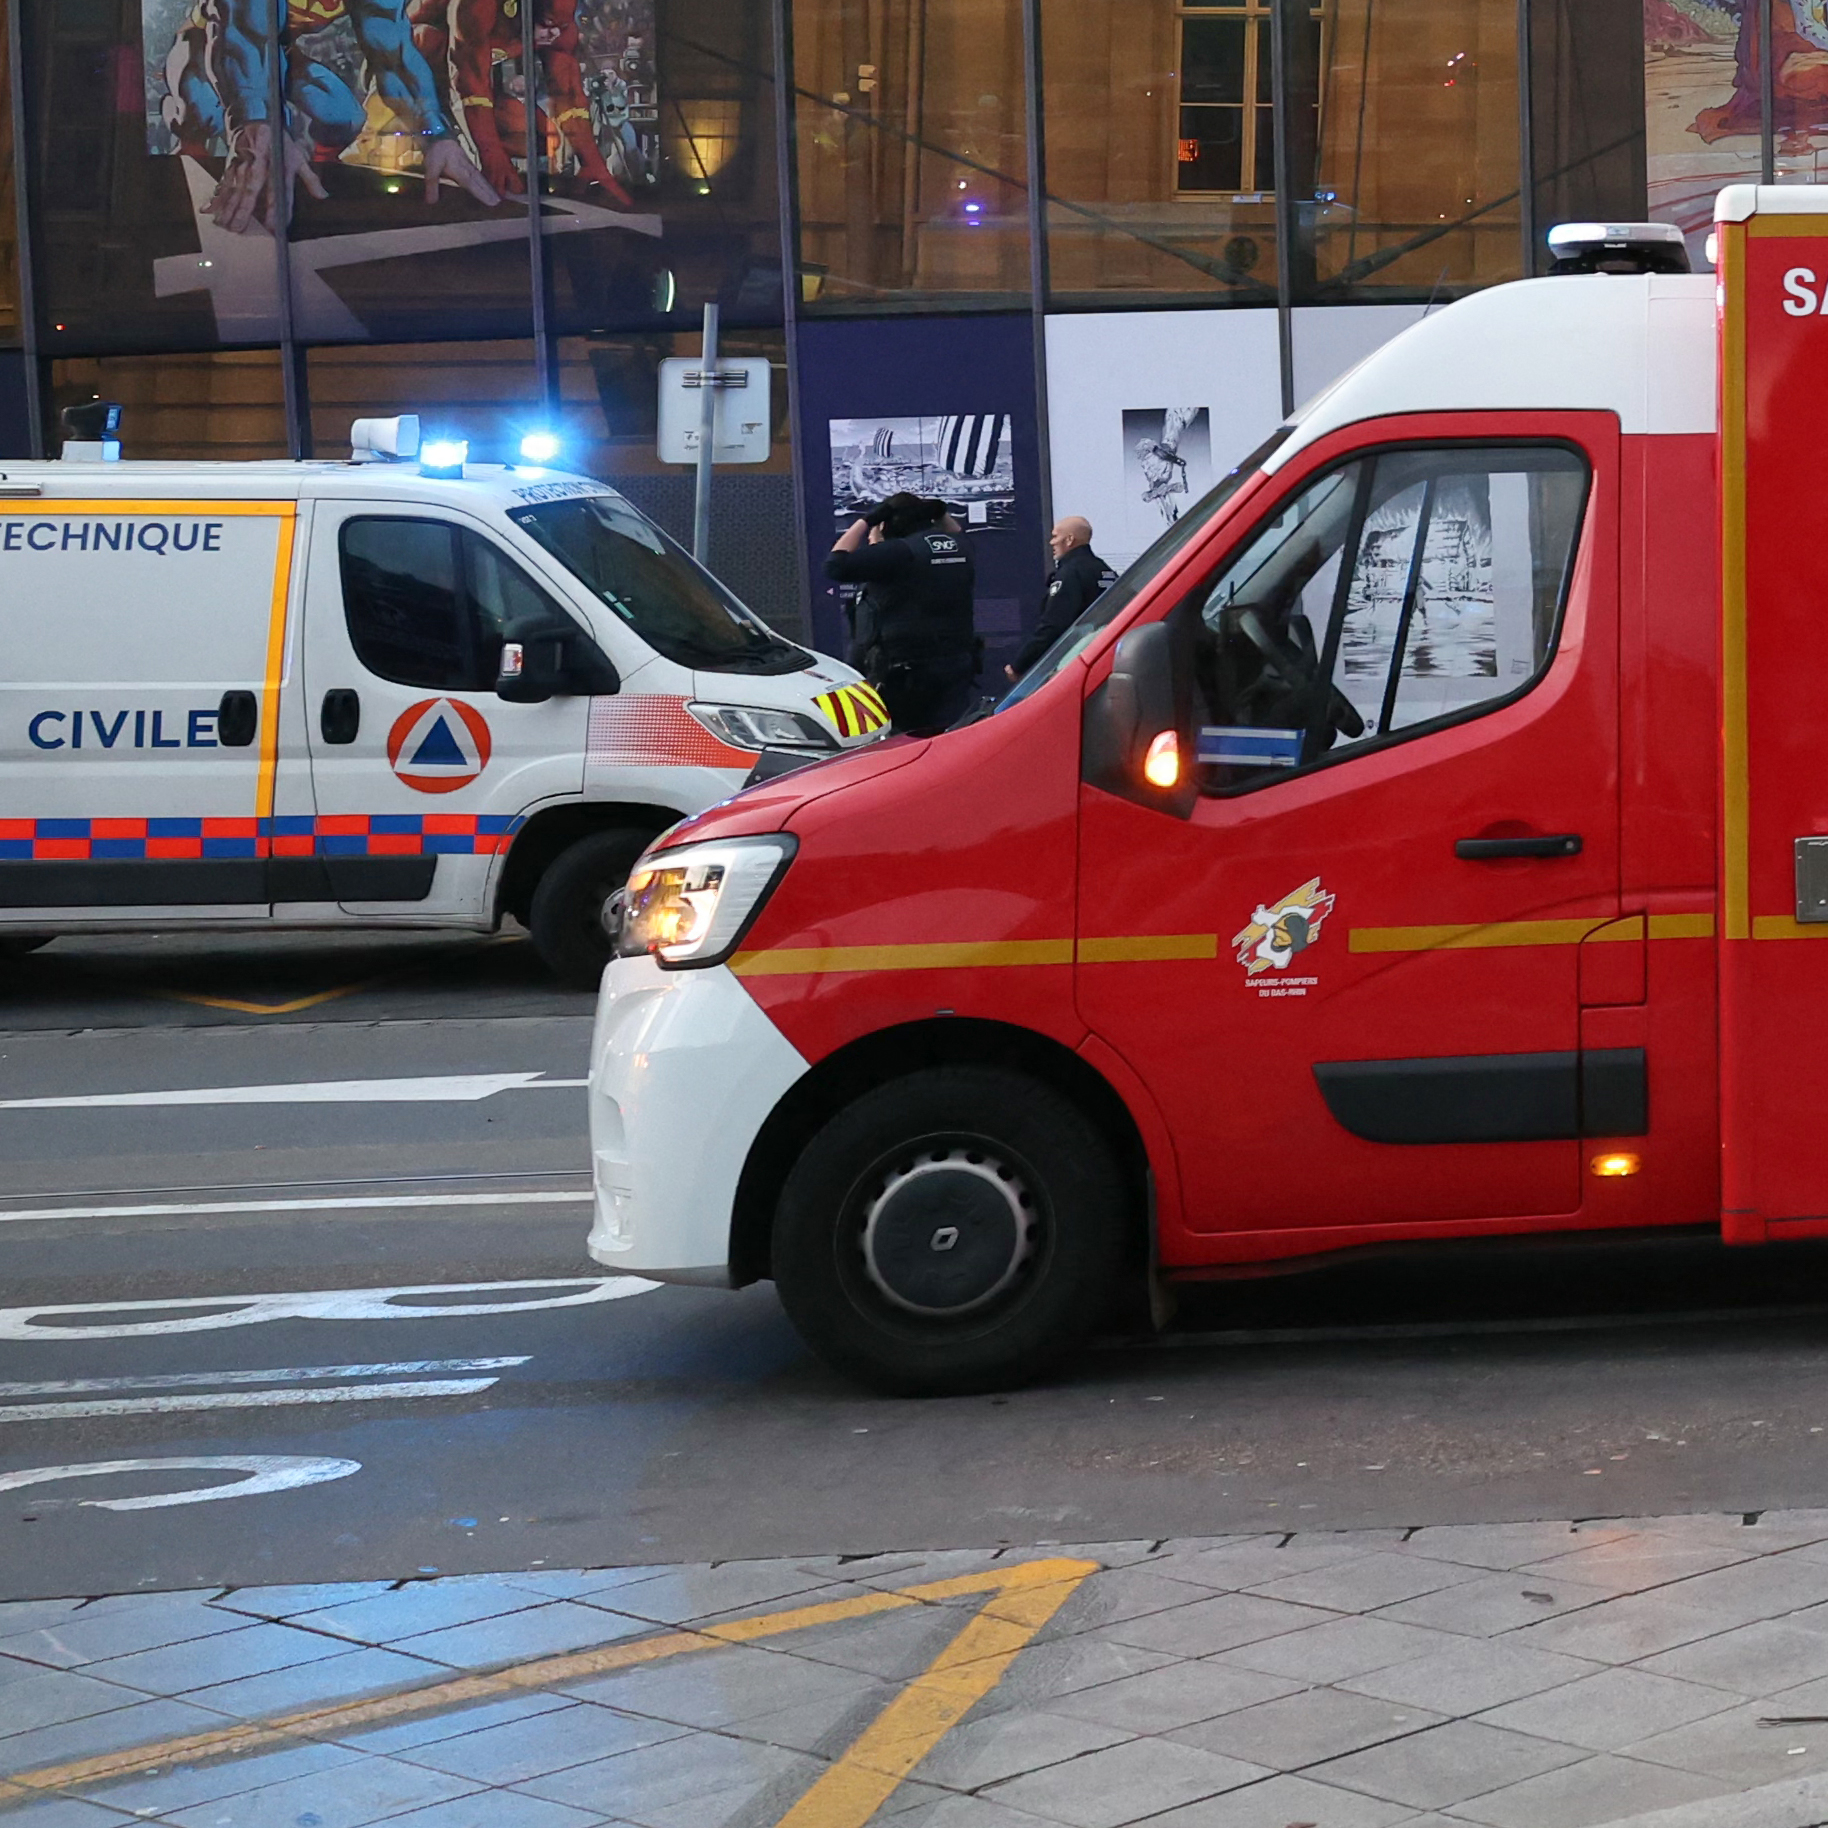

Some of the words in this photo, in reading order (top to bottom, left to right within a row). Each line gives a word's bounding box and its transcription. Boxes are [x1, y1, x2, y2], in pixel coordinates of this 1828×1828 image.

[0, 523, 223, 556] ECHNIQUE
[933, 541, 956, 551] SNCF
[29, 710, 219, 749] CIVILE
